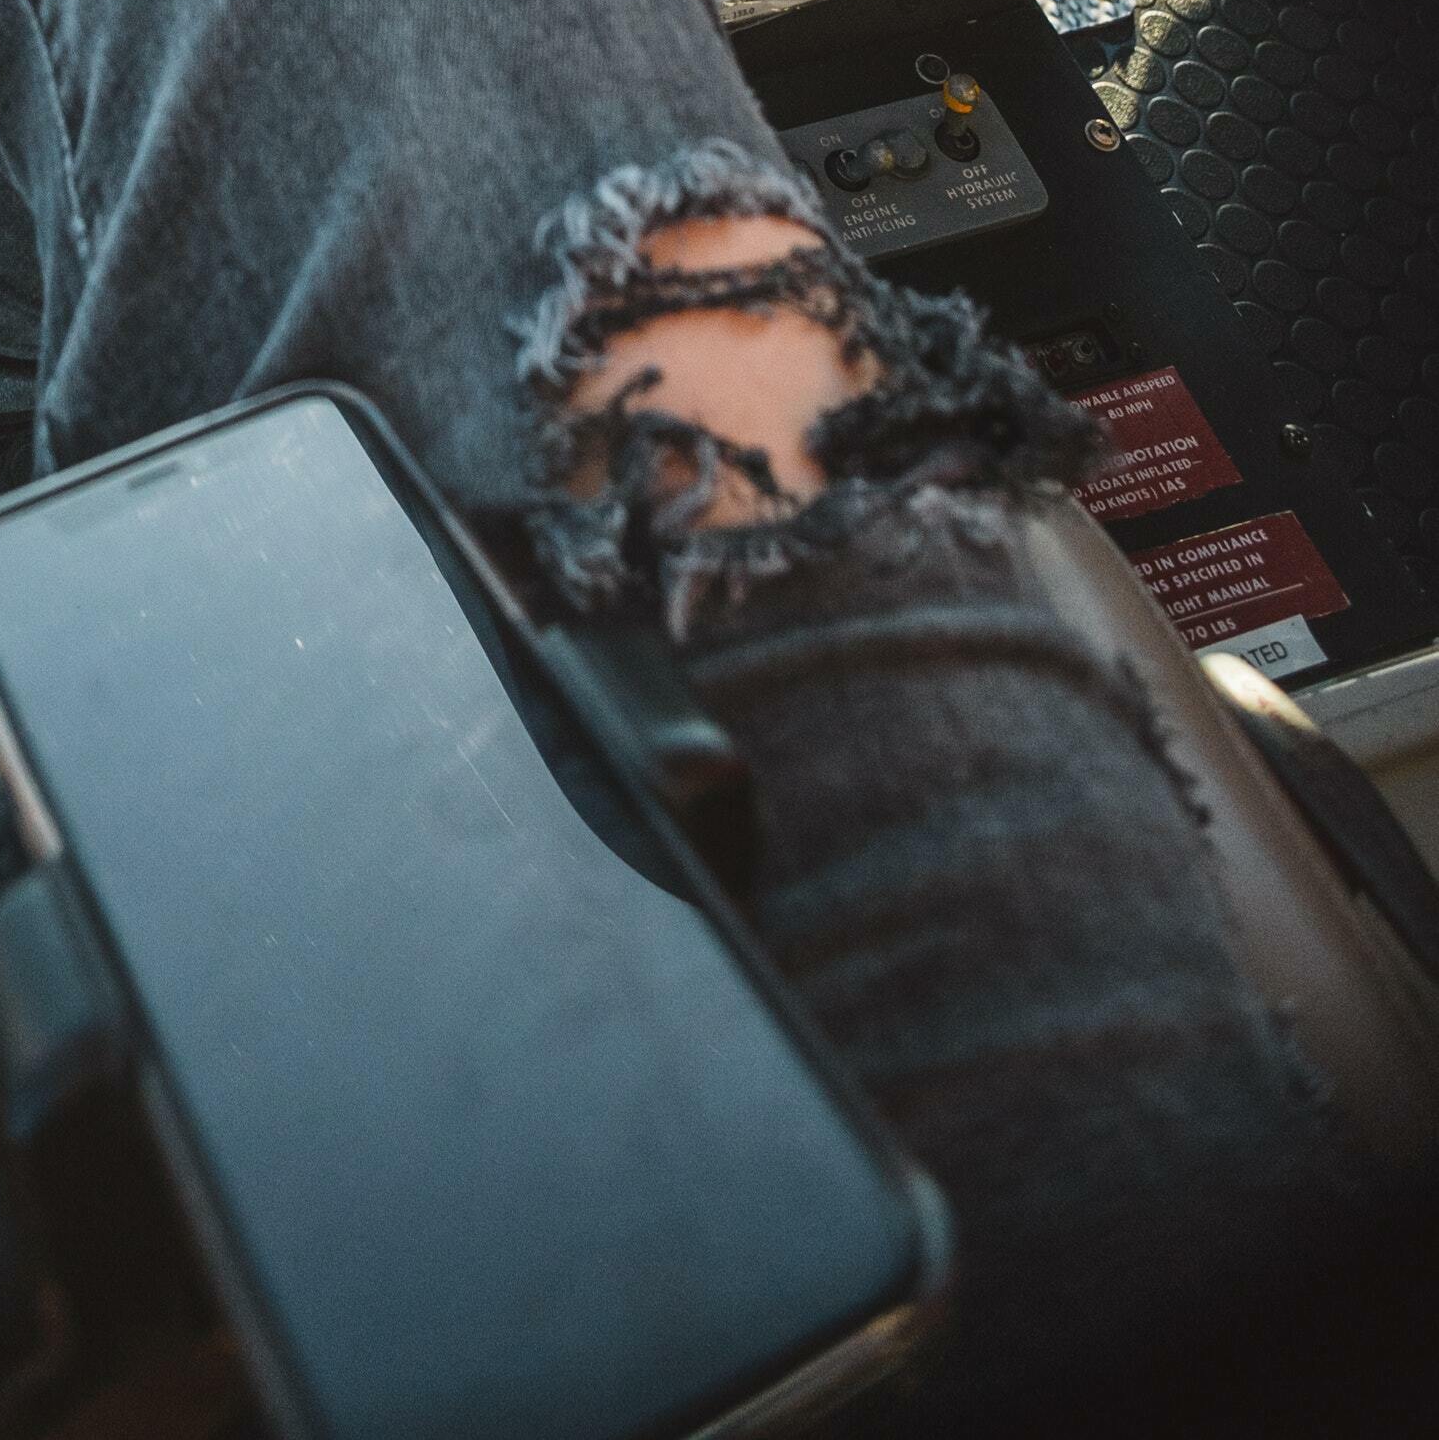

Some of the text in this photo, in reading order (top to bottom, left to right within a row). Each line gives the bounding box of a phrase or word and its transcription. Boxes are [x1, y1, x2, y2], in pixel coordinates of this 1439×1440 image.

[963, 164, 988, 179] OFF
[946, 171, 1019, 200] HYDRAULIC
[966, 189, 1016, 209] SYSTEM
[844, 203, 899, 226] ENGINE
[841, 215, 916, 241] ANTI-ICING
[1123, 375, 1175, 397] AIRSPEED
[1126, 399, 1153, 414] MPH
[1088, 475, 1134, 494] FLOATS
[1089, 477, 1186, 513] 60 IAS
[1155, 528, 1269, 571] IN COMPLIANCE
[1173, 553, 1264, 588] SPECIFIED IN
[1208, 576, 1270, 604] MANUAL
[1210, 618, 1237, 634] LBS
